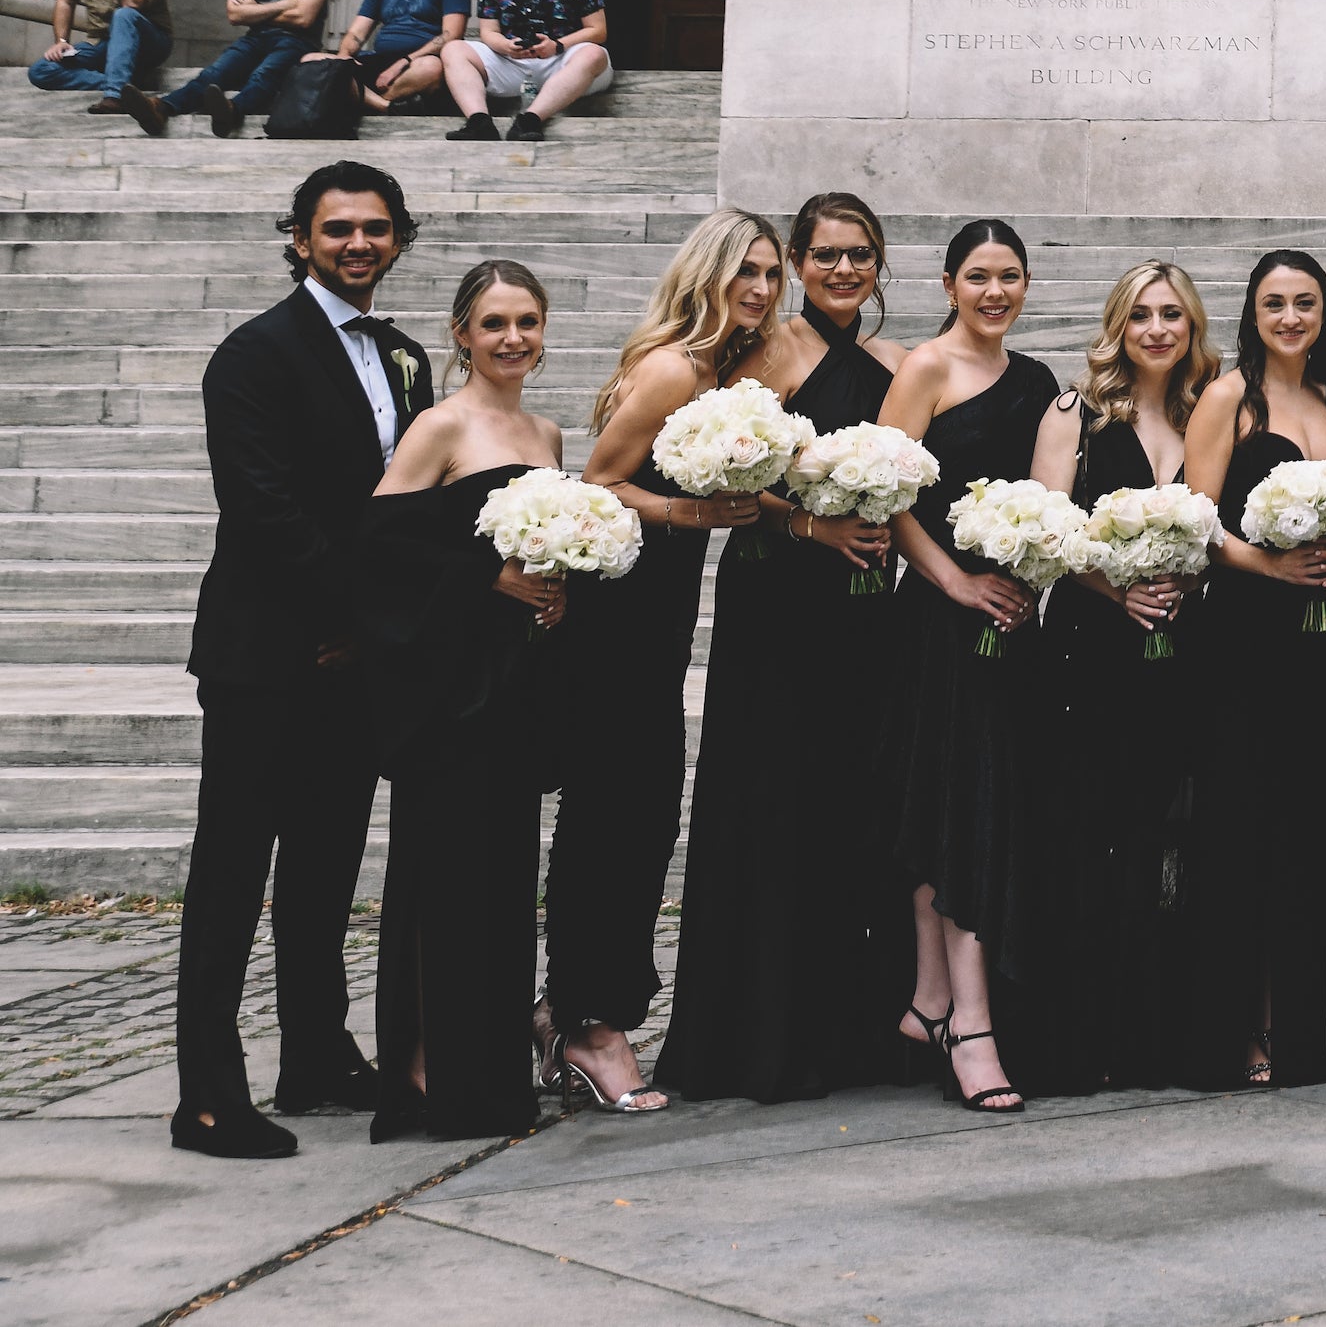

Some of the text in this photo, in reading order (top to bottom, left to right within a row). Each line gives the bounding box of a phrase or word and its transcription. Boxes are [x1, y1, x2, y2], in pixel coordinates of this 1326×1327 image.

[924, 33, 1045, 50] STEPHEN
[1073, 35, 1260, 51] SCHWARZMAN
[1031, 69, 1152, 85] BUILDING
